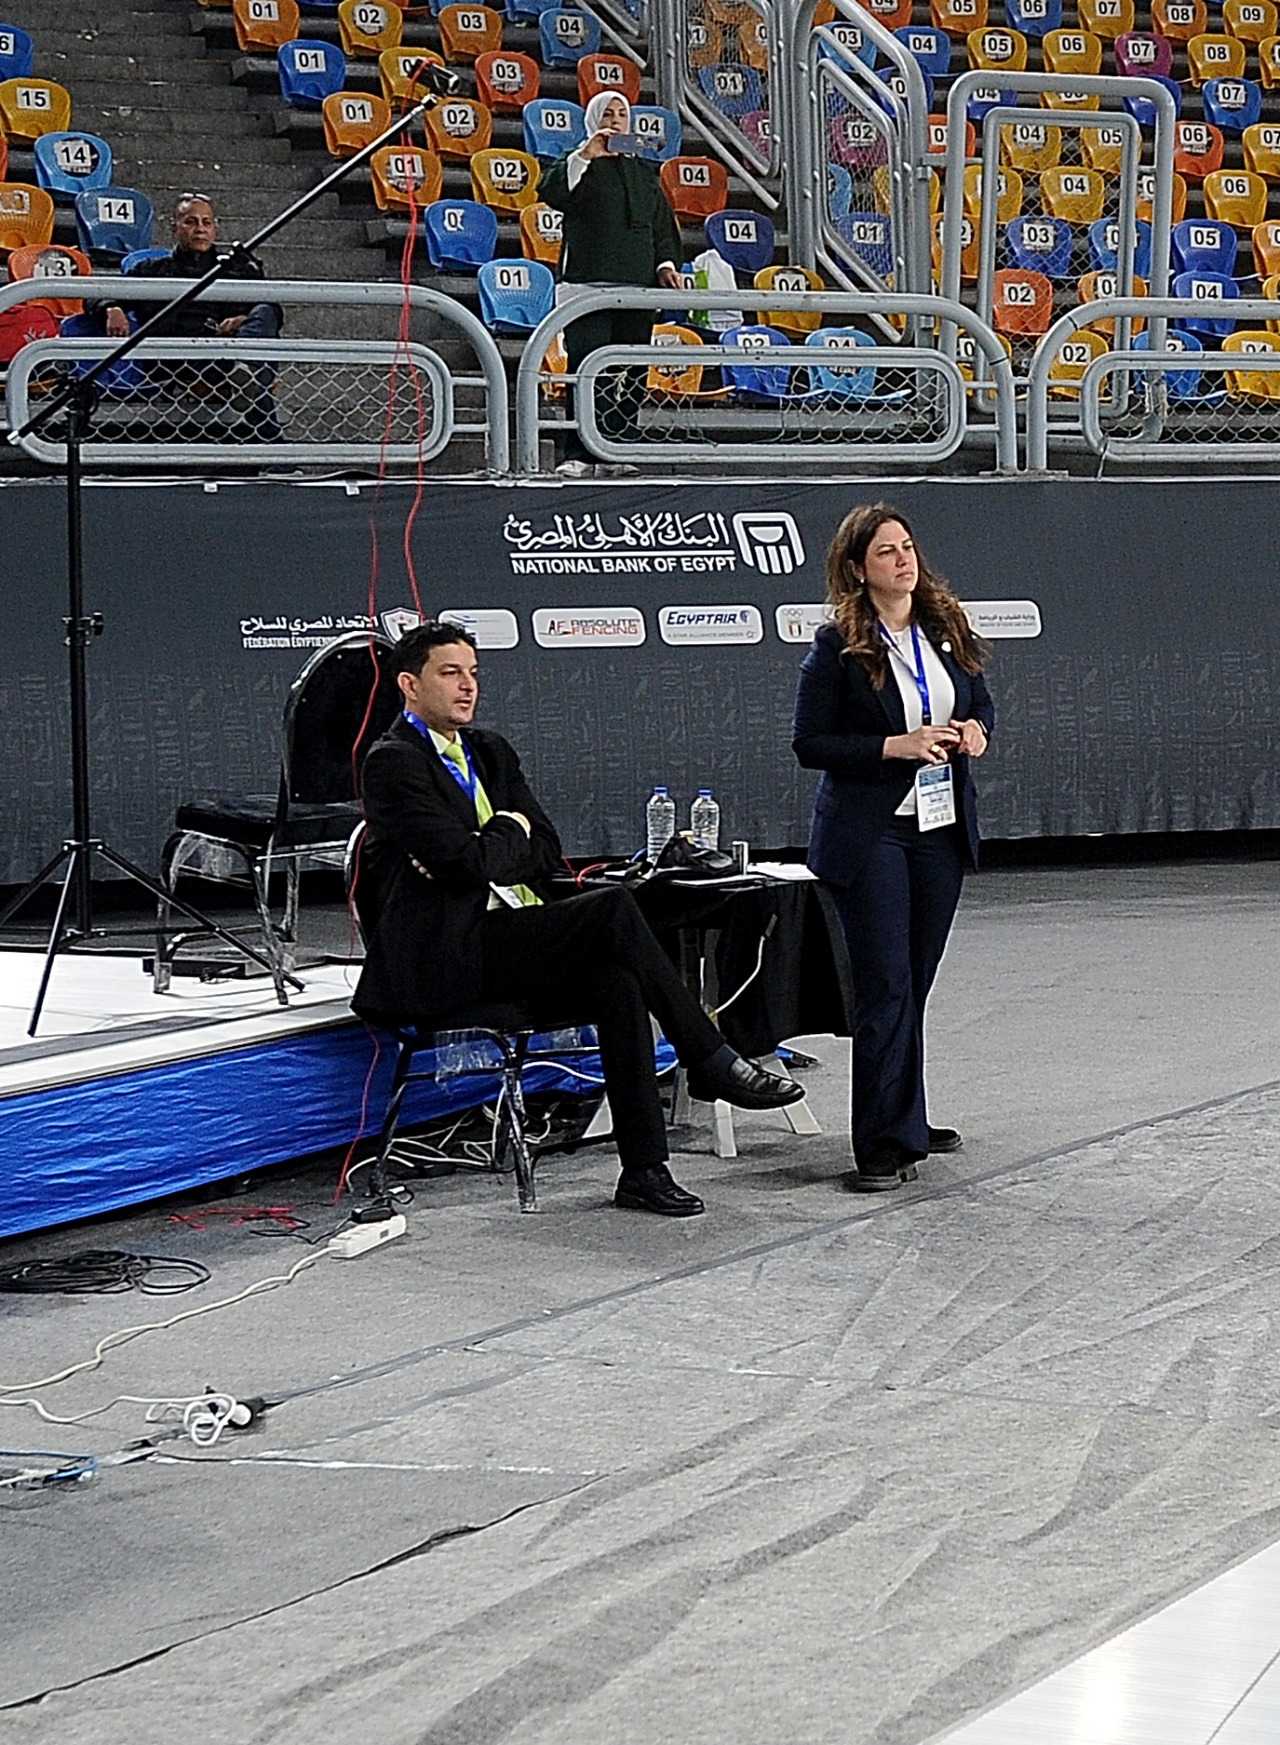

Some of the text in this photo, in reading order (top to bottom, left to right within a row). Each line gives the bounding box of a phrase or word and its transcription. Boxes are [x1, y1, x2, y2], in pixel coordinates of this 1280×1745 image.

[253, 2, 272, 18] 01
[953, 1, 974, 13] 05
[1024, 1, 1043, 13] 06
[1099, 1, 1117, 15] 07
[1171, 8, 1190, 21] 08
[1243, 8, 1261, 21] 09
[359, 8, 380, 24] 02
[461, 14, 482, 29] 03
[560, 18, 580, 33] 04
[838, 30, 858, 45] 03
[913, 37, 933, 51] 04
[988, 37, 1008, 52] 05
[1062, 37, 1082, 51] 06
[1132, 43, 1150, 56] 07
[1207, 46, 1227, 60] 08
[299, 52, 319, 68] 01
[496, 64, 517, 79] 03
[599, 66, 619, 81] 04
[22, 91, 46, 107] 15
[1222, 86, 1241, 100] 07
[346, 104, 366, 120] 01
[447, 109, 470, 124] 02
[545, 112, 566, 128] 03
[639, 118, 660, 134] 04
[1183, 127, 1203, 142] 06
[61, 147, 86, 163] 14
[395, 157, 416, 173] 01
[494, 162, 517, 178] 02
[683, 167, 706, 183] 04
[1064, 177, 1086, 192] 04
[1225, 179, 1246, 194] 06
[104, 202, 129, 220] 14
[729, 223, 752, 239] 04
[1194, 230, 1217, 246] 05
[500, 269, 522, 287] 01
[1008, 286, 1031, 302] 02
[1196, 284, 1218, 299] 04
[1063, 345, 1087, 362] 02
[512, 556, 736, 574] NATIONAL BANK OF EGYPT
[667, 612, 737, 625] EGYPTAIR
[571, 626, 638, 635] FENCING
